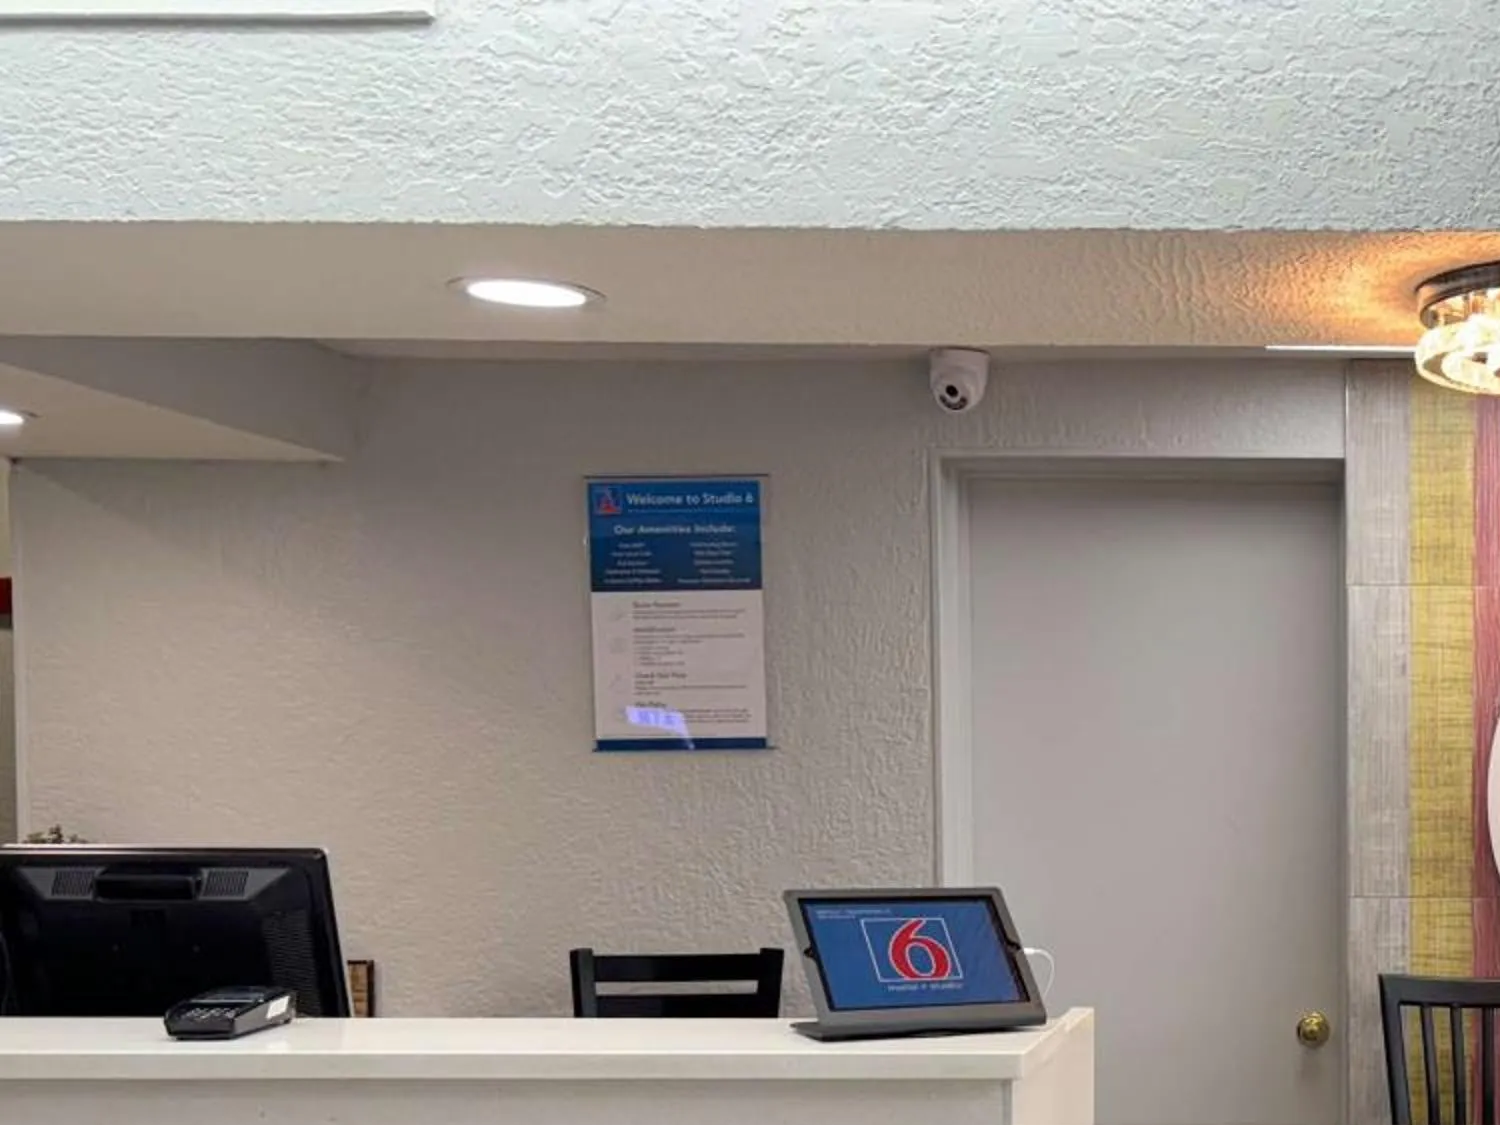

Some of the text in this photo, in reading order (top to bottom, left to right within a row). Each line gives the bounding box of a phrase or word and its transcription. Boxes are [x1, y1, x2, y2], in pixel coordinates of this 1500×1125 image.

[626, 493, 683, 505] Welcome
[687, 493, 700, 504] to
[613, 525, 635, 535] Our
[637, 524, 692, 535] Amenities
[888, 917, 952, 982] 6
